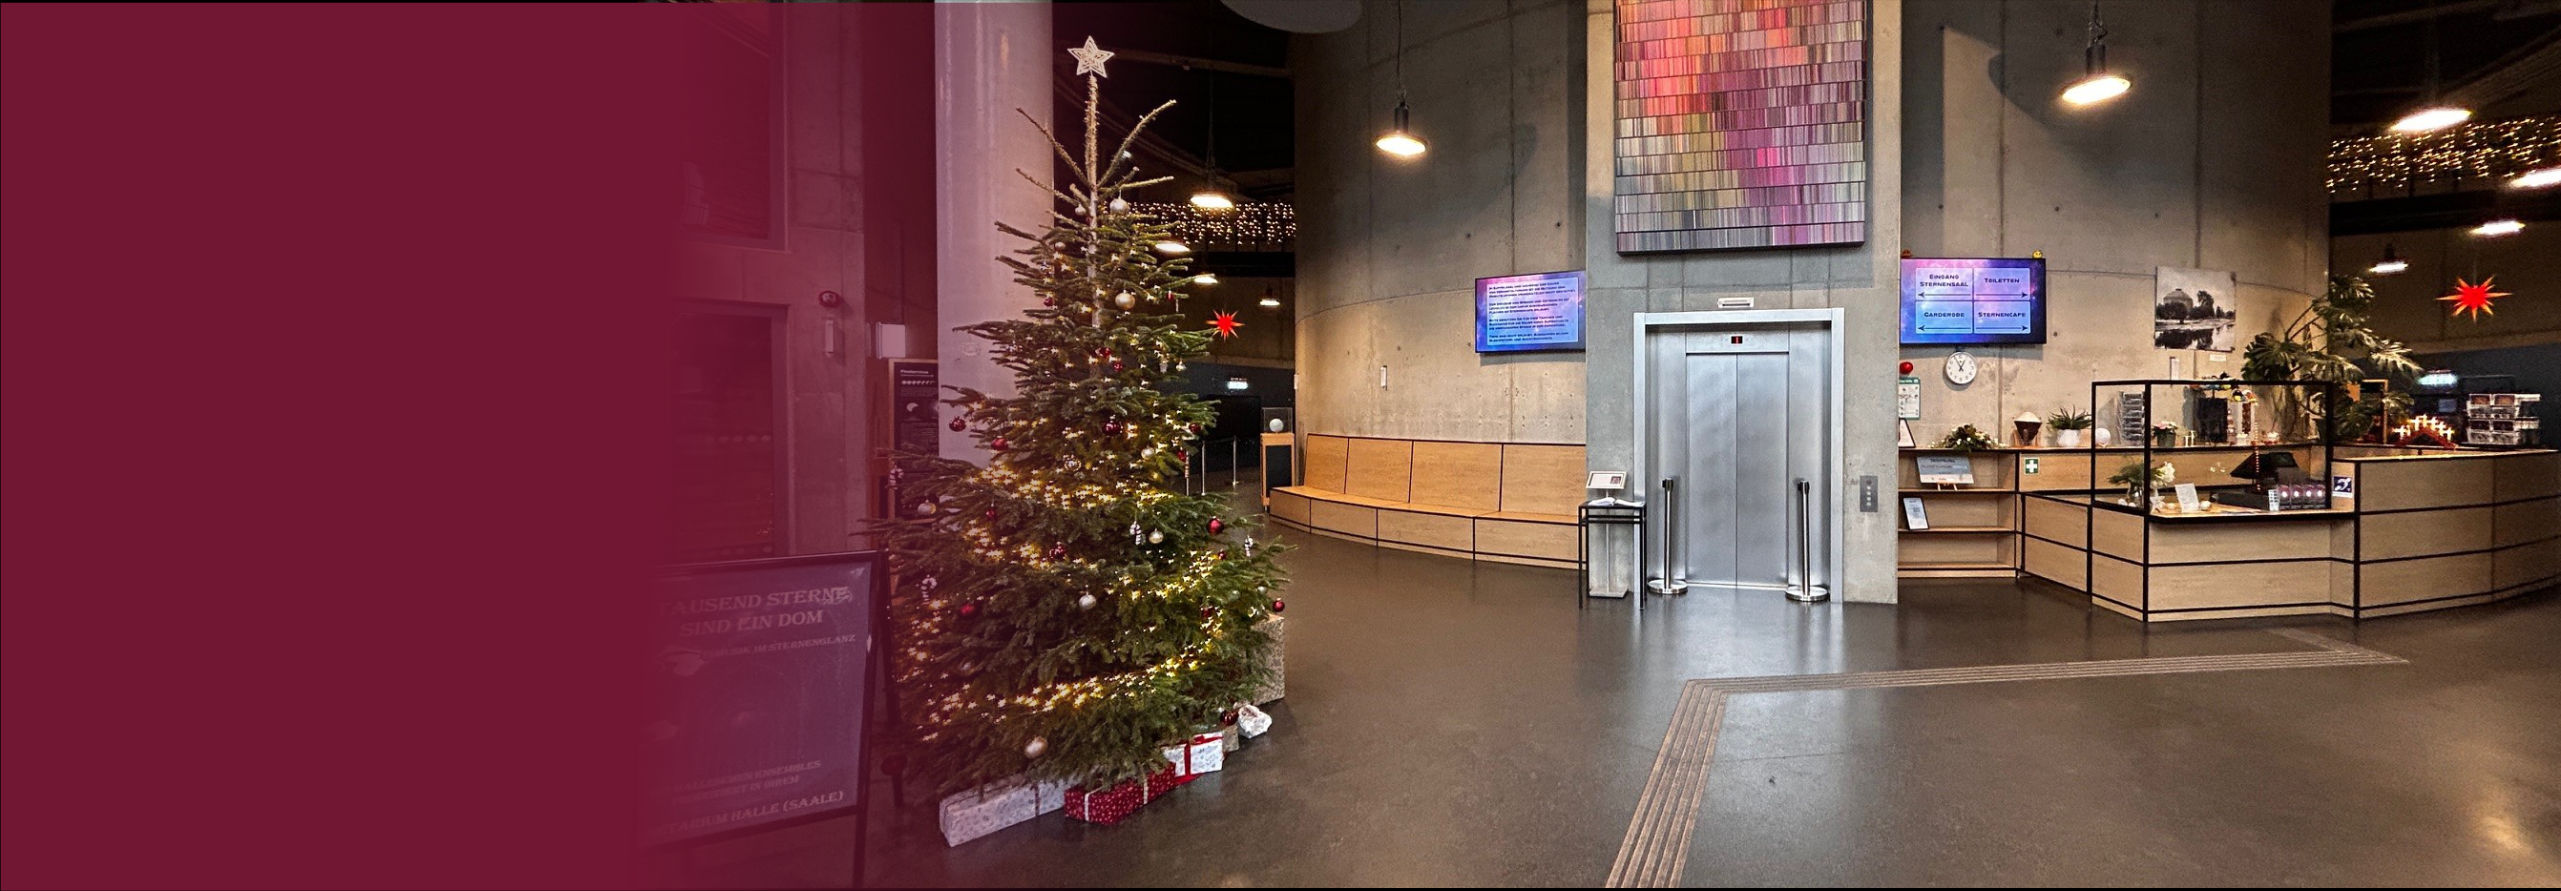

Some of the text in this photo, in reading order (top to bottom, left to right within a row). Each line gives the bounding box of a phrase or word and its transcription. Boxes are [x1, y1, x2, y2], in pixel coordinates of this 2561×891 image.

[656, 586, 851, 617] TAUSEND STERNE
[679, 609, 824, 637] SIND EIN DOM
[731, 801, 780, 822] HALLE
[783, 790, 845, 812] (SAALE)
